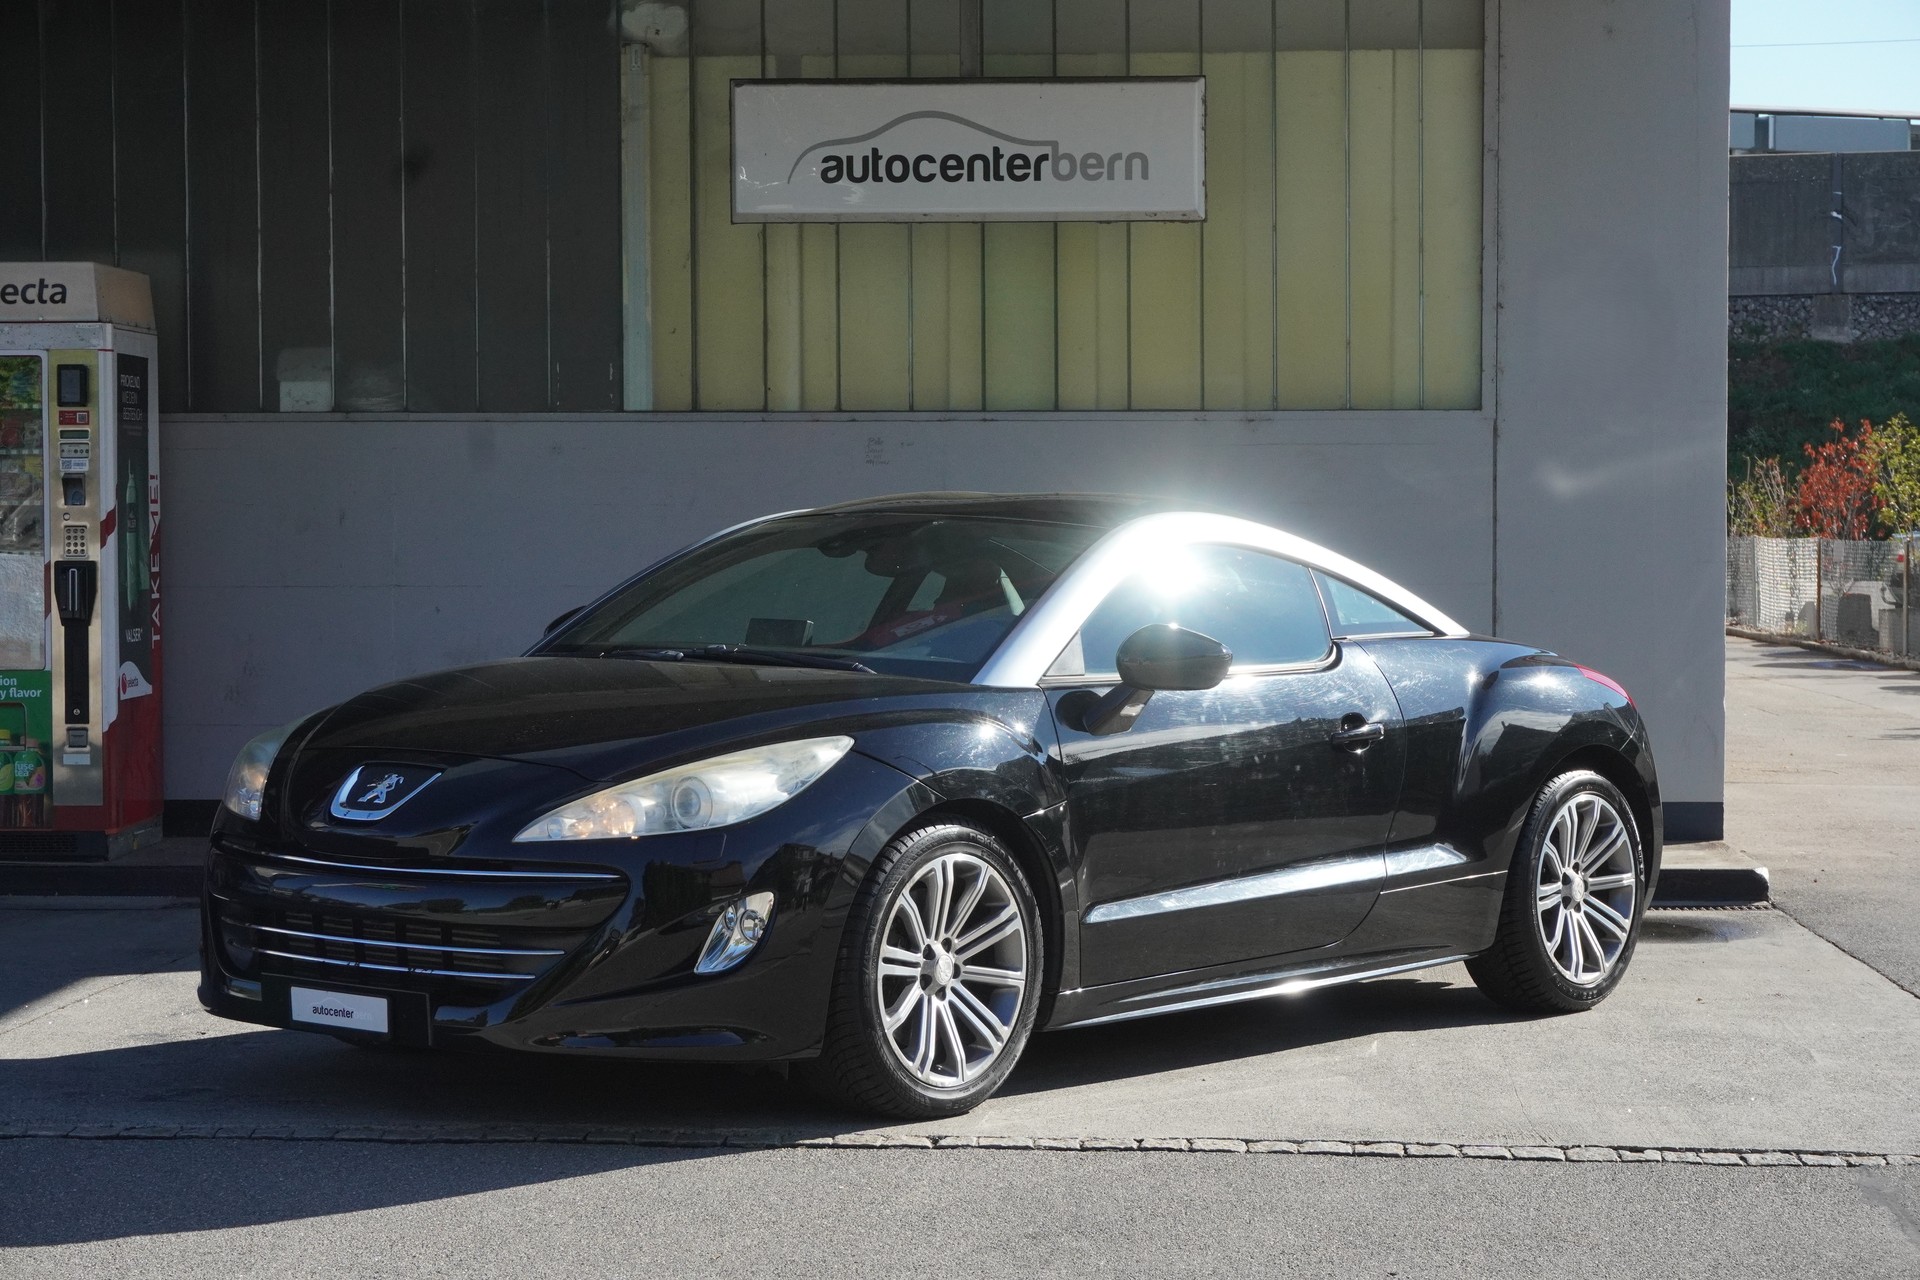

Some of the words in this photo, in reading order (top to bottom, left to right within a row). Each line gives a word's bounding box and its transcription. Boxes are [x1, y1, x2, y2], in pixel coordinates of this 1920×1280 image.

[820, 146, 1149, 184] autocenterbern
[151, 553, 160, 649] TAKE
[9, 687, 42, 698] flavor
